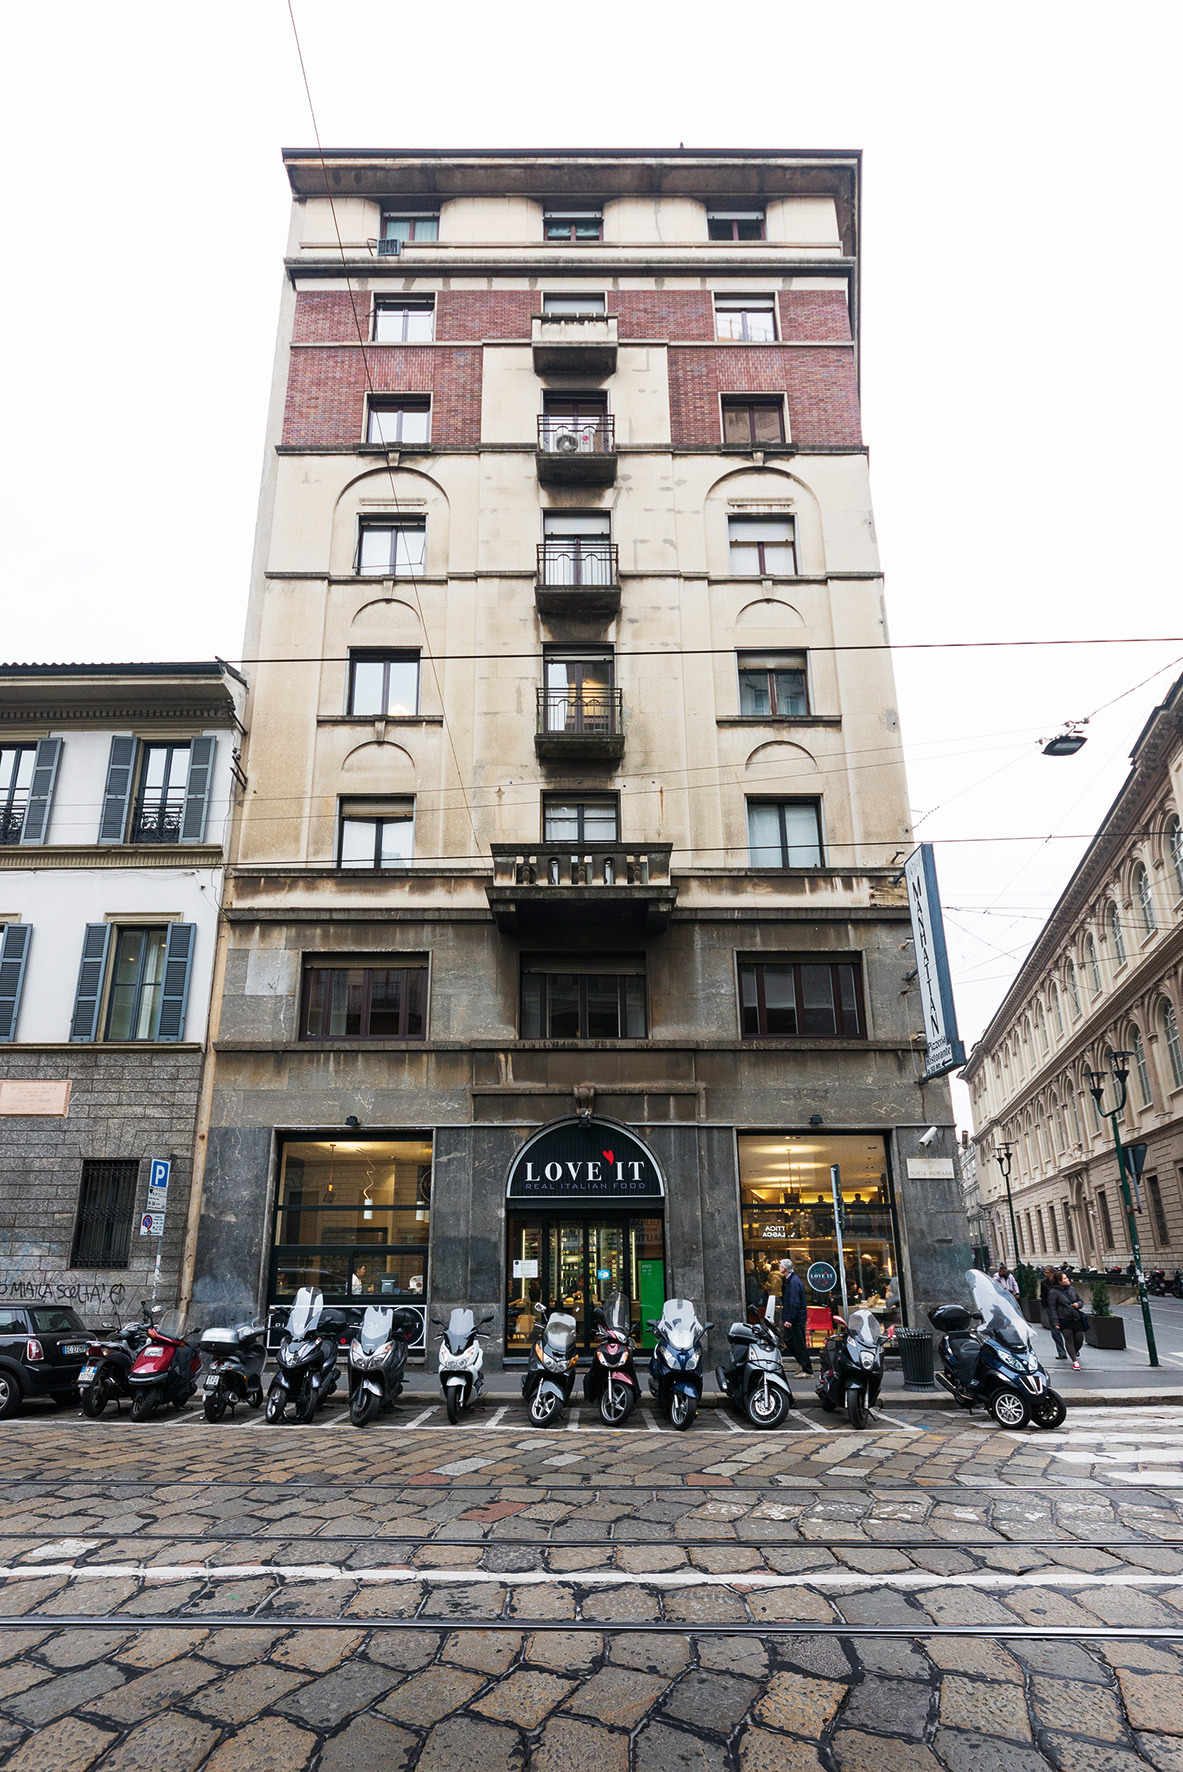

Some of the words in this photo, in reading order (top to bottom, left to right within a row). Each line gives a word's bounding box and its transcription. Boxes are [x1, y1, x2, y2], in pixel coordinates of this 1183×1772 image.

[911, 876, 940, 1038] MANHATTAN
[927, 1035, 946, 1053] Pizzeria
[926, 1046, 951, 1066] Ristorante
[154, 1164, 166, 1184] P
